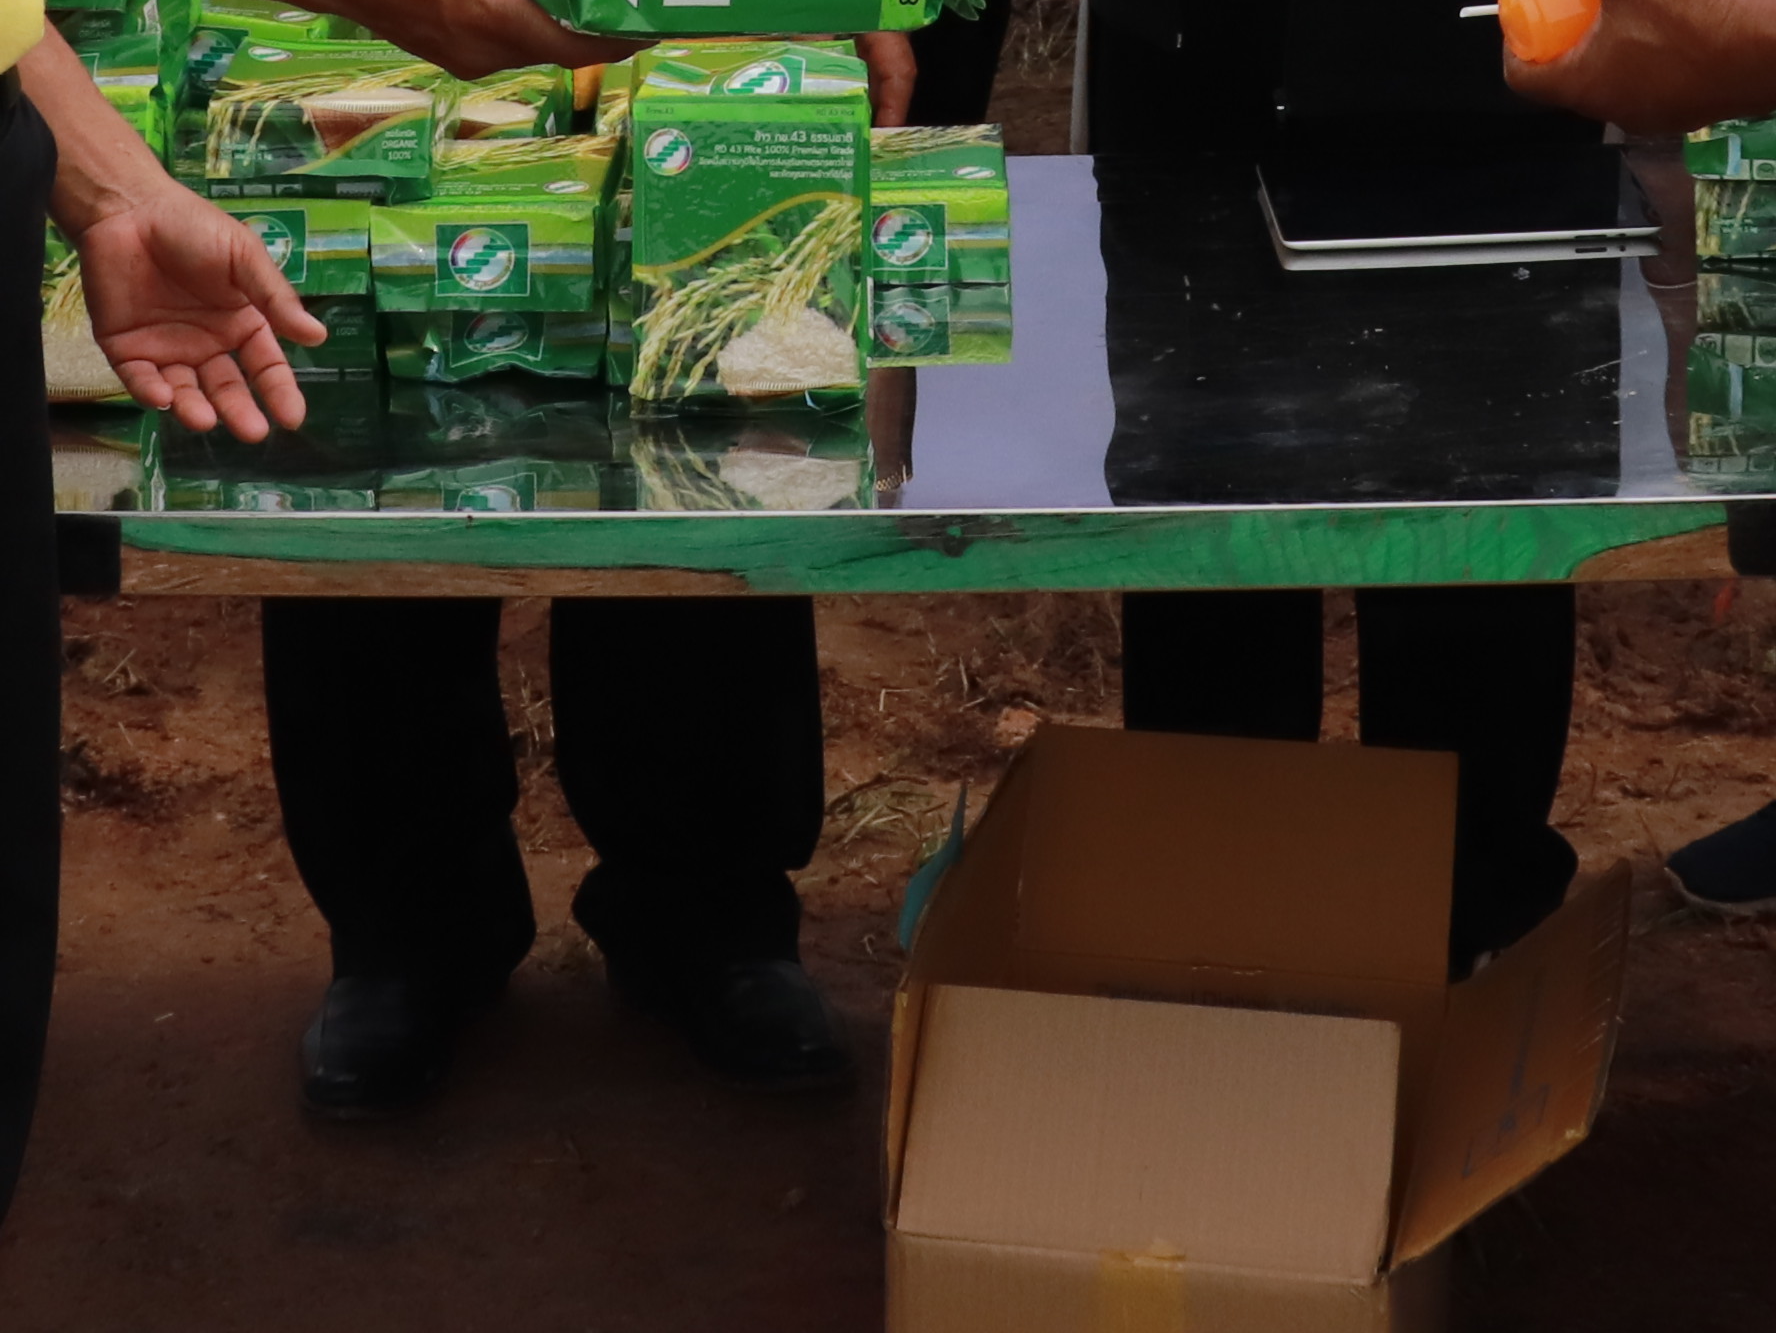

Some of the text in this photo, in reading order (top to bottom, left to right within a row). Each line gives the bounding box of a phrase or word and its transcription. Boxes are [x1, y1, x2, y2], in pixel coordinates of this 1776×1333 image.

[381, 139, 419, 150] ORGANIC
[764, 145, 790, 155] 100%
[387, 151, 412, 161] 100%
